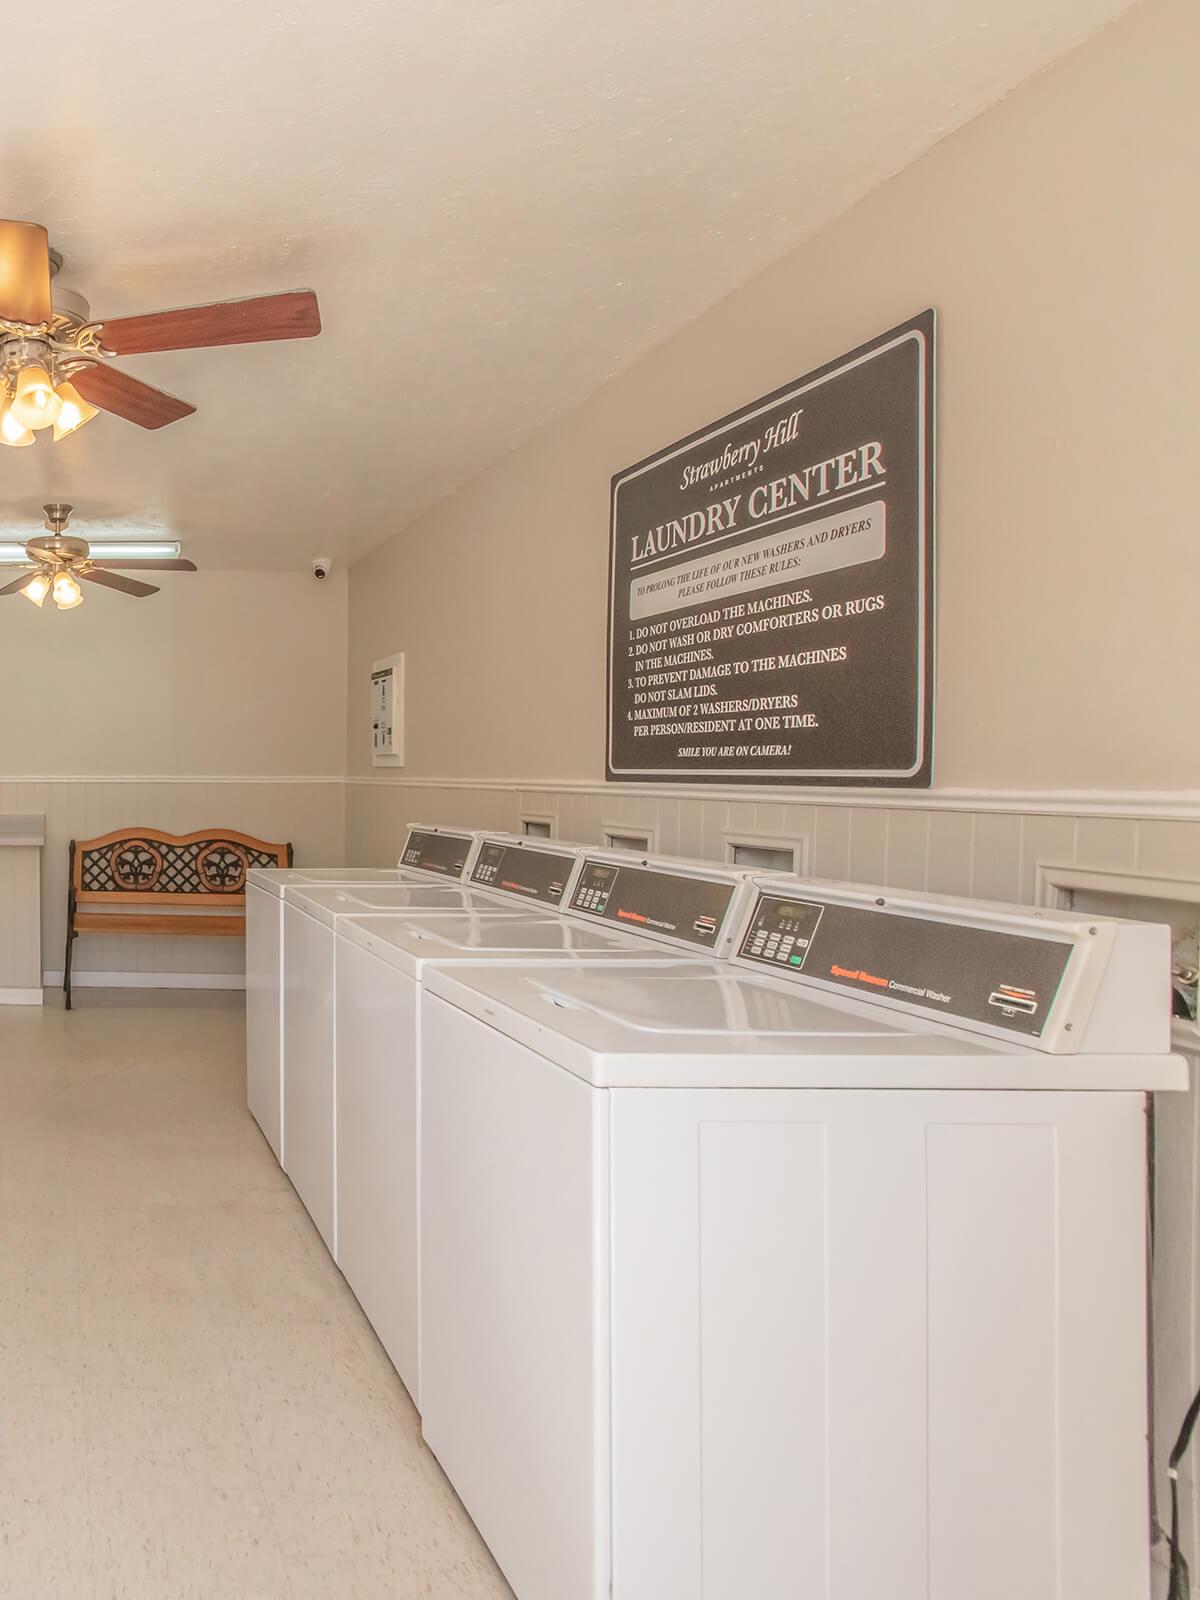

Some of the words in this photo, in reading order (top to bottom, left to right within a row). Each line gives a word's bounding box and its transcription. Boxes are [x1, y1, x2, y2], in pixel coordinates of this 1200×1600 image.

[680, 439, 760, 490] Strawberry
[763, 409, 804, 453] Hill
[709, 464, 764, 492] APARTMENTS
[631, 494, 742, 562] LAUNDRY
[748, 441, 887, 519] CENTER
[636, 586, 646, 597] TO
[645, 578, 676, 596] PROLONG
[677, 572, 692, 585] THE
[691, 567, 709, 580] LIFE
[710, 564, 721, 575] OF
[722, 558, 740, 571] OUR
[741, 551, 761, 566] NEW
[762, 538, 806, 559] WASHERS
[807, 531, 829, 548] AND
[830, 518, 872, 540] DRYERS
[678, 583, 705, 598] PLEASE
[706, 573, 738, 591] FOLLOW
[740, 565, 767, 582] THESE
[769, 556, 801, 575] RULES:
[628, 646, 635, 657] 2.
[635, 643, 648, 655] DO
[649, 639, 668, 653] NOT
[669, 633, 695, 648] WASH
[696, 631, 711, 644] OR
[712, 625, 735, 641] DRY
[736, 608, 819, 636] COMFORTERS
[822, 603, 843, 620] OR
[845, 595, 885, 616] RUGS
[629, 630, 635, 641] 1.
[636, 626, 649, 639] DO
[649, 622, 669, 636] NOT
[669, 610, 721, 632] OVERLOAD
[722, 604, 745, 620] THE
[747, 589, 813, 615] MACHINES.
[627, 678, 634, 689] 3.
[634, 676, 647, 688] TO
[647, 670, 688, 686] PREVENT
[689, 663, 731, 680] DAMAGE
[733, 661, 749, 674] TO
[751, 657, 776, 672] THE
[778, 646, 847, 669] MACHINES
[635, 661, 644, 672] IN
[645, 657, 662, 670] THE
[663, 648, 714, 667] MACHINES.
[634, 692, 647, 704] DO
[647, 690, 667, 702] NOT
[667, 686, 692, 700] SLAM
[693, 684, 718, 698] LIDS.
[634, 706, 678, 720] MAXIMUM
[679, 704, 692, 717] OF
[693, 704, 699, 716] 2
[700, 694, 798, 714] WASHERS/DRYERS
[633, 725, 649, 737] PER
[650, 719, 737, 736] PERSON/RESIDENT
[738, 718, 753, 731] AT
[754, 716, 781, 730] ONE
[782, 713, 819, 729] TIME.
[677, 746, 701, 757] SMILE
[701, 746, 718, 757] YOU
[718, 746, 735, 757] ARE
[736, 745, 749, 756] ON
[749, 744, 792, 756] CAMERA!
